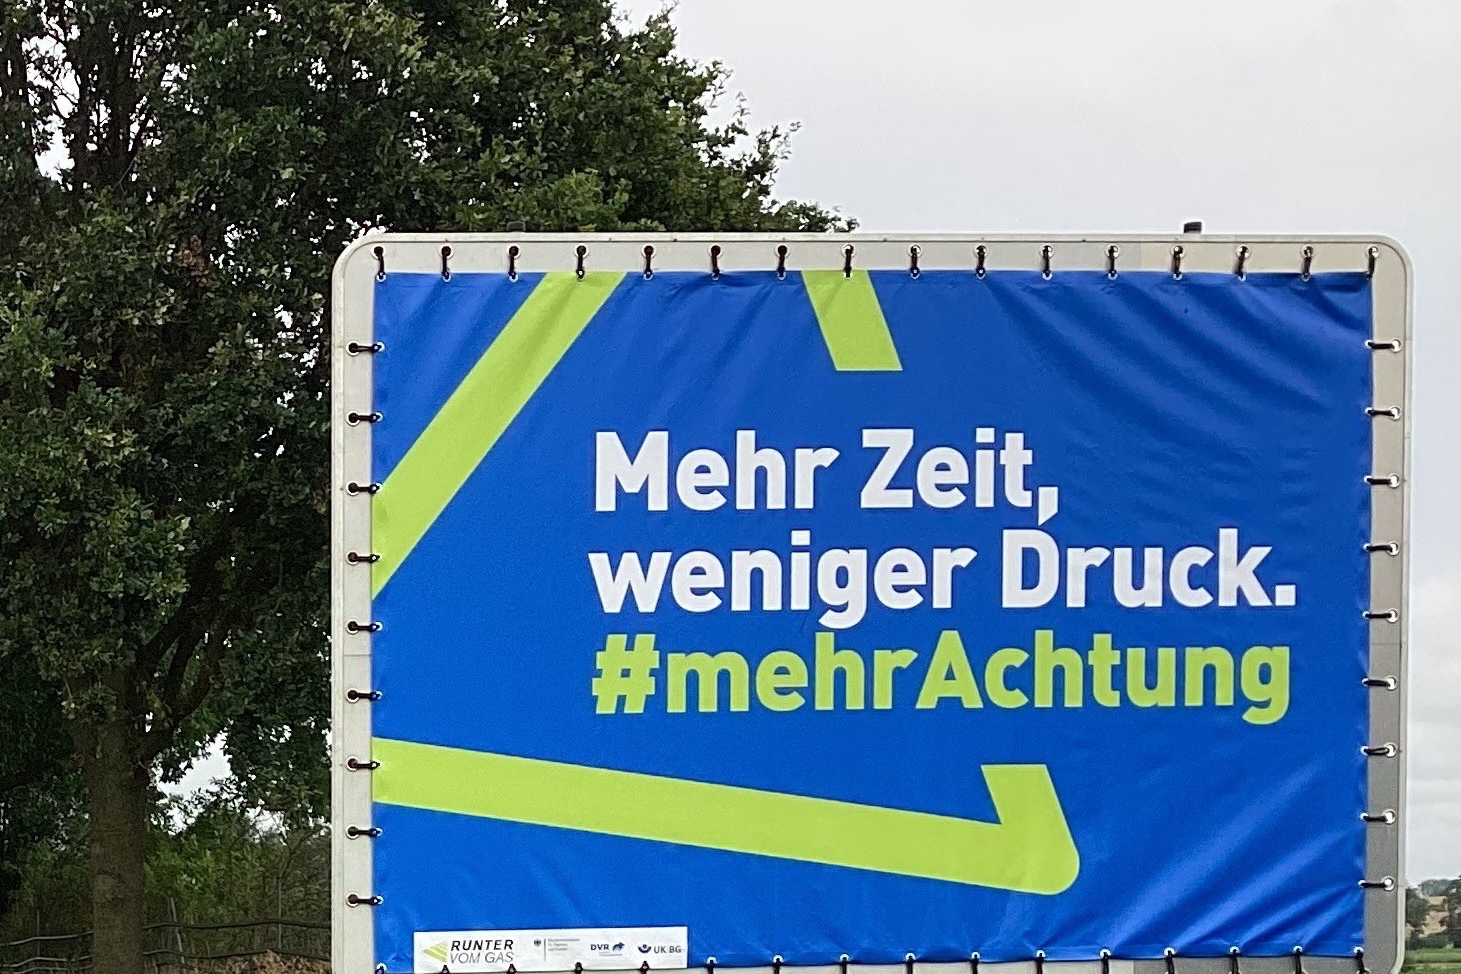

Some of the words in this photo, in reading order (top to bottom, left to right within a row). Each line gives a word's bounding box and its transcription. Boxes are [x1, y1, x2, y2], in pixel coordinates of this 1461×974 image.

[595, 429, 840, 512] Mehr
[860, 427, 1059, 526] Zeit,
[588, 530, 977, 629] weniger
[1002, 528, 1296, 608] Druck.
[592, 629, 1290, 725] #mehrAchtung
[450, 939, 514, 951] RUNTER
[590, 943, 609, 951] DVR
[653, 945, 667, 953] UK
[669, 945, 682, 953] BG
[450, 952, 481, 964] VOM
[484, 951, 514, 963] GAS
